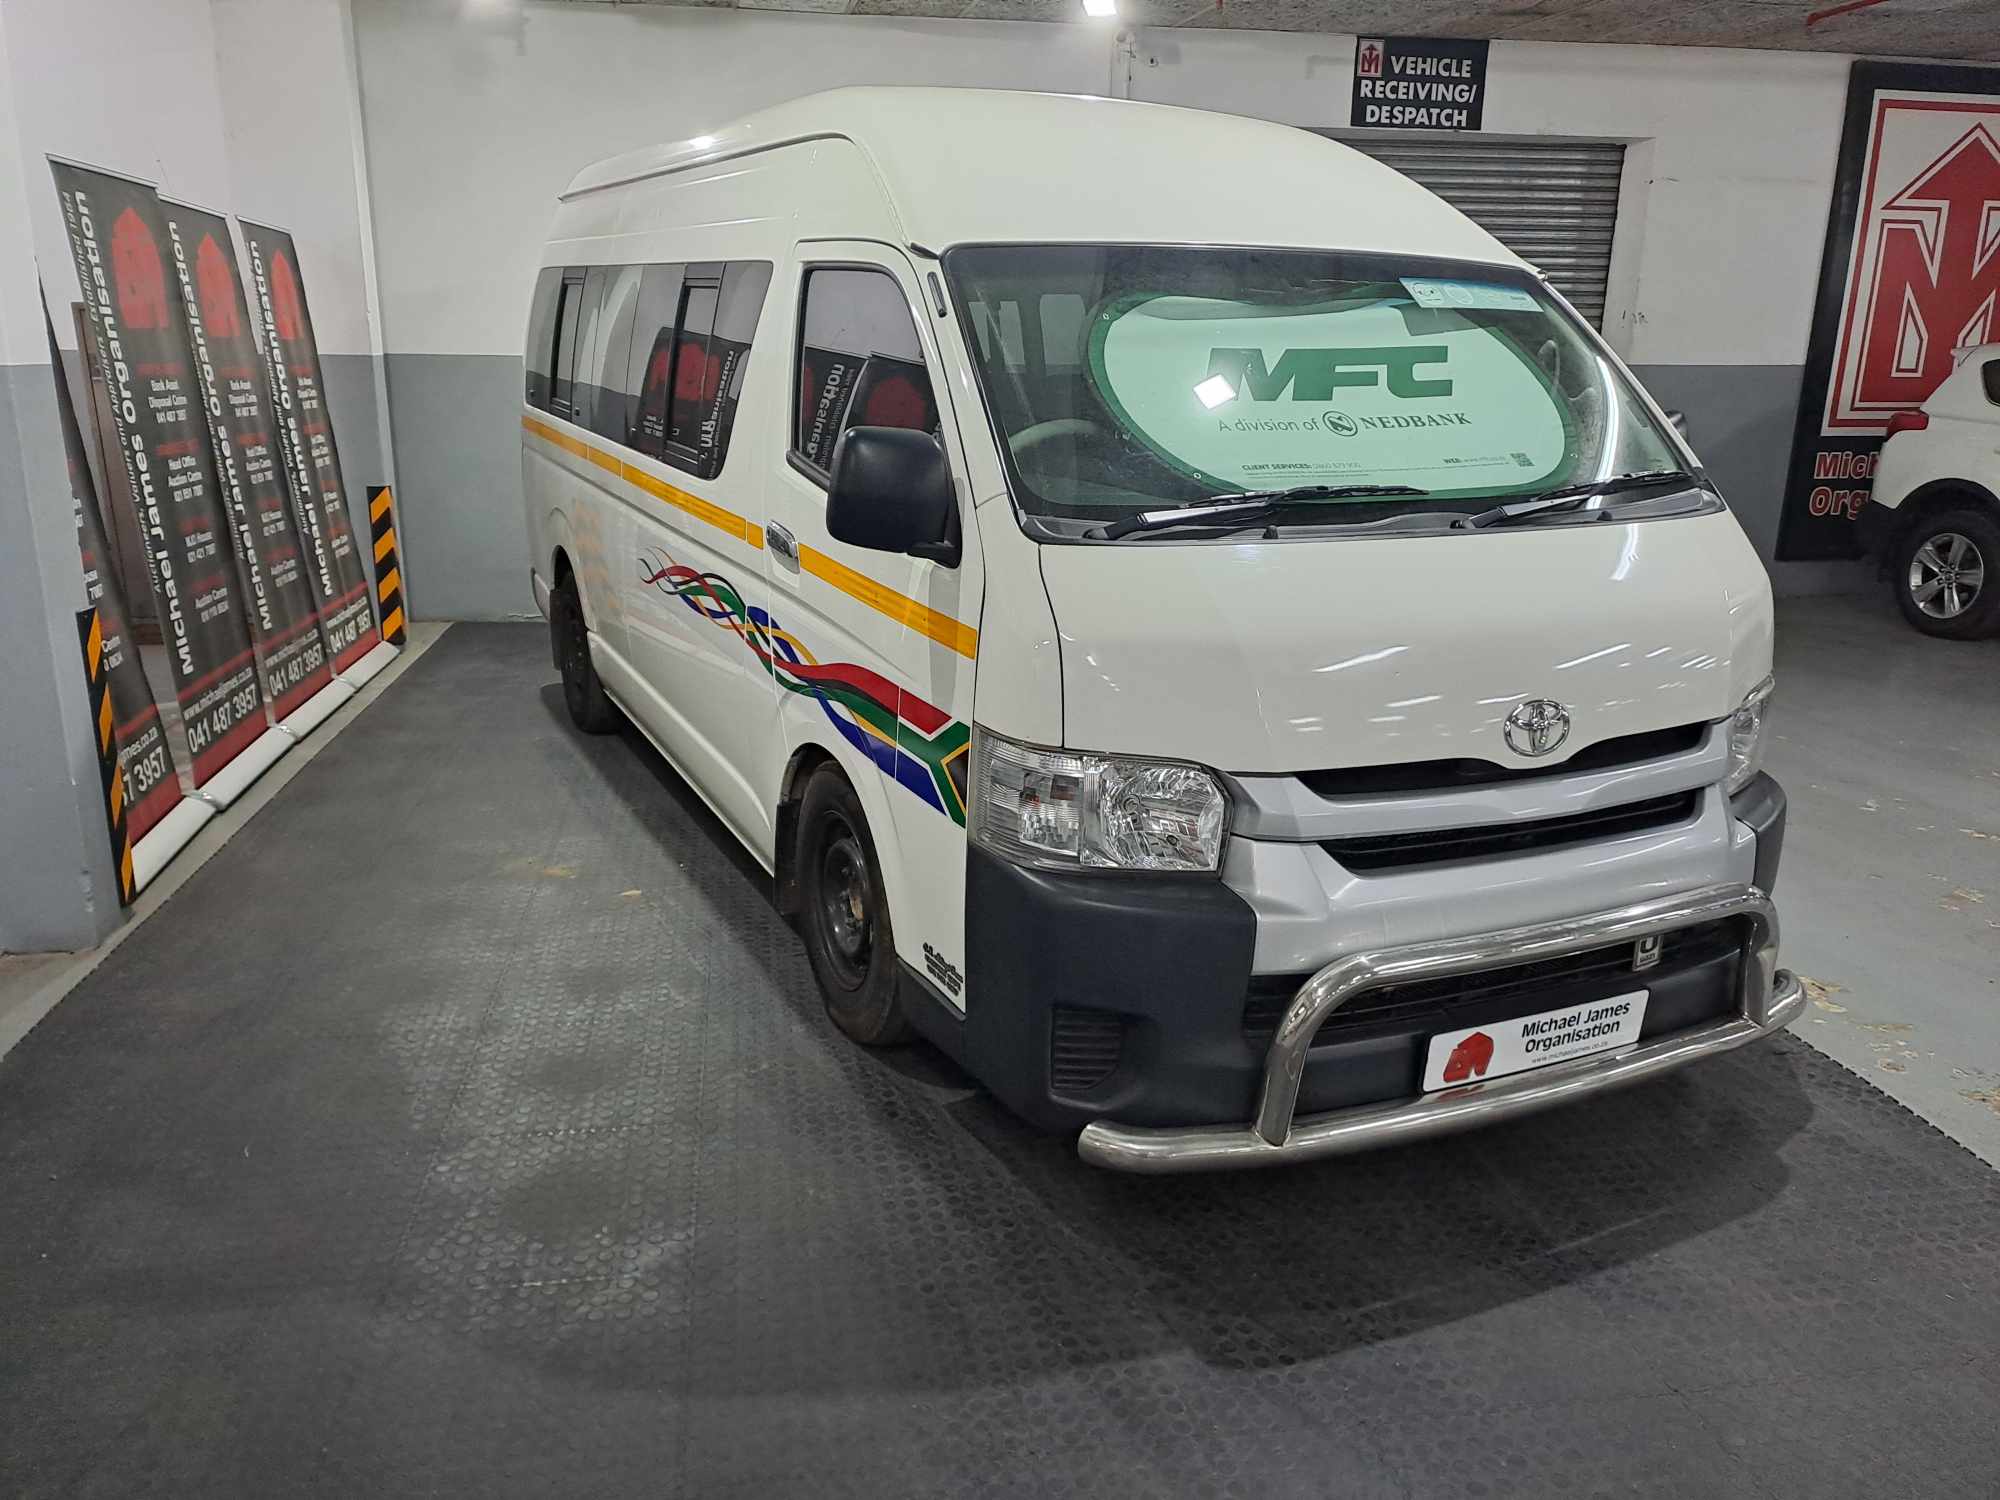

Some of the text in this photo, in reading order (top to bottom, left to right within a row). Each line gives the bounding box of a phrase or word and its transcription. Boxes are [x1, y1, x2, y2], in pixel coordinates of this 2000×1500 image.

[1359, 79, 1477, 103] RECEIVING/
[1390, 55, 1473, 78] VEHICLE
[1365, 104, 1468, 127] DESPATCH
[75, 191, 137, 424] Organisation
[168, 221, 221, 417] Organisation
[250, 240, 292, 410] Organisation
[1205, 345, 1454, 401] MFC
[115, 417, 128, 446] and
[1218, 412, 1473, 432] A division of NEDBANK
[124, 449, 140, 502] Valuers
[218, 425, 246, 516] James
[287, 417, 312, 497] James
[131, 434, 165, 541] James
[239, 523, 273, 631] Michael
[305, 502, 333, 597] Michael
[156, 550, 194, 676] Michael
[269, 643, 322, 696] 041 487 3957
[188, 683, 257, 752] 041 487 3957
[133, 745, 165, 792] 3957
[1521, 1002, 1631, 1038] Michael James
[1525, 1020, 1621, 1053] Organisation
